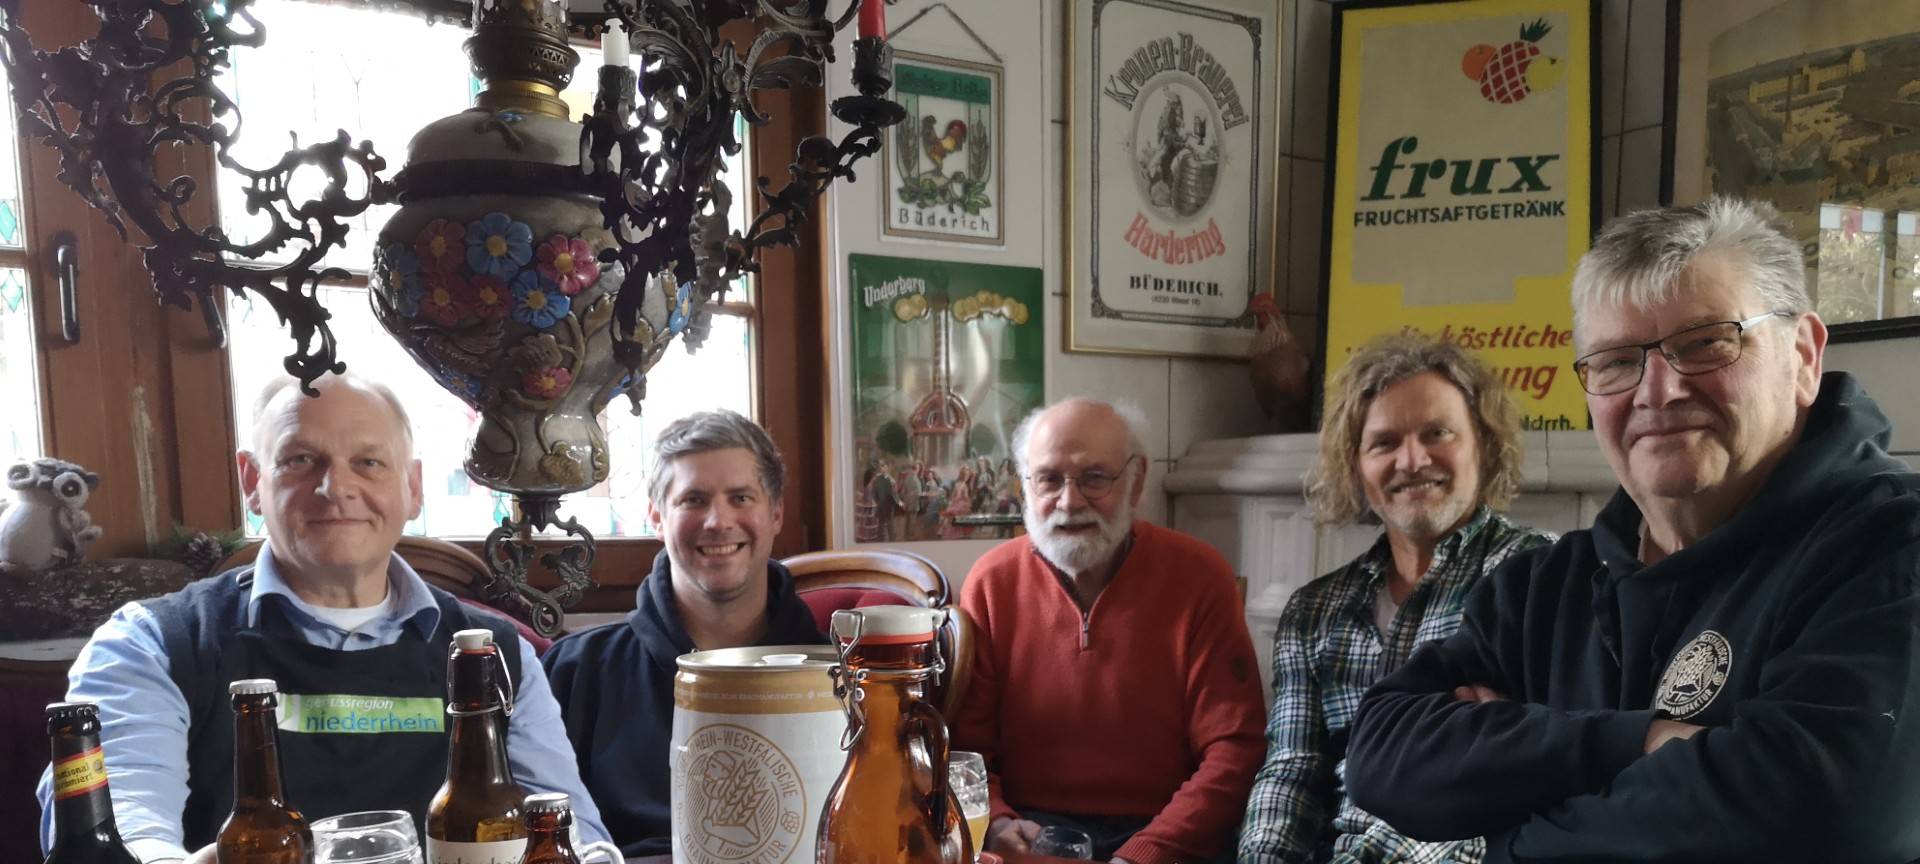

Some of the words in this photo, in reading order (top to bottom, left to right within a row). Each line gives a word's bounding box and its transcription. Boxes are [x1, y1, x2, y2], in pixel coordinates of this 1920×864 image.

[1104, 31, 1249, 131] Kronen-Brauerei
[1360, 136, 1560, 200] frux
[898, 207, 990, 232] Büderich
[1353, 200, 1566, 228] FRUCHTSAFTGETRÄNK
[1124, 211, 1226, 265] Hardering
[864, 276, 926, 307] Underberg
[1439, 324, 1573, 352] köstliche
[306, 711, 438, 731] niederrhein
[677, 728, 799, 798] HEIN-WESTFÄLISCHE
